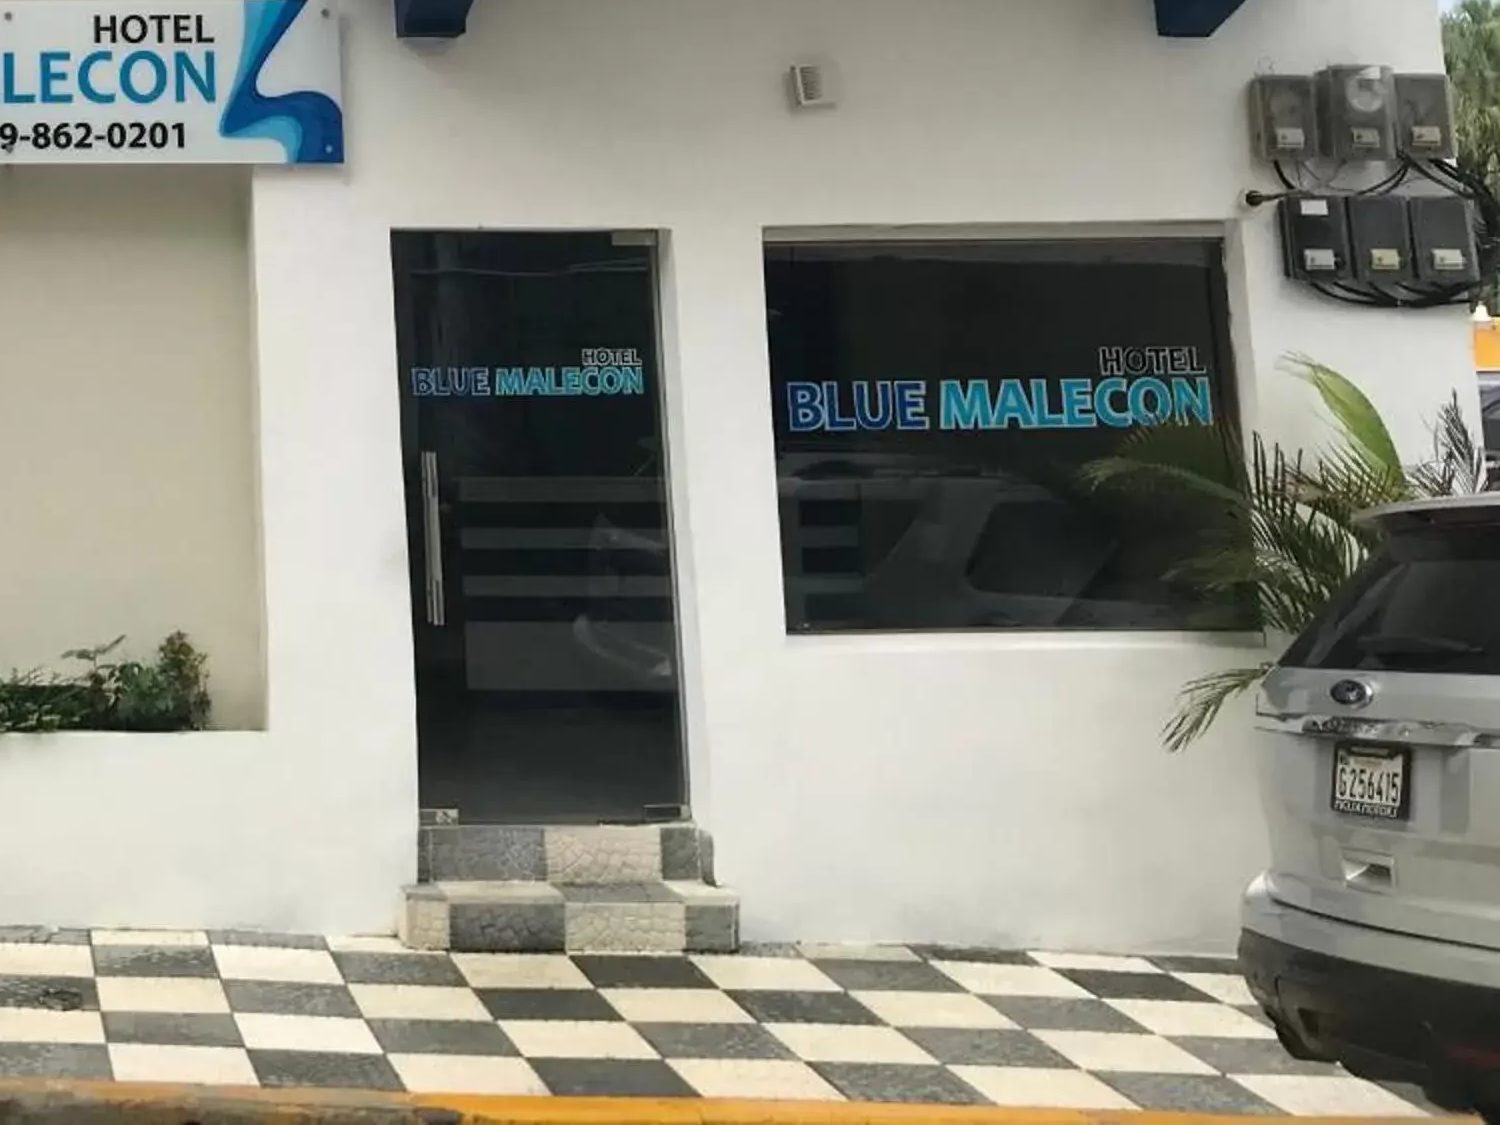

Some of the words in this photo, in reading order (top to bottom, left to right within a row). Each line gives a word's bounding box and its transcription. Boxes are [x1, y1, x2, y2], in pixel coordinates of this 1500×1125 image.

[93, 14, 215, 44] HOTEL
[581, 347, 643, 366] HOTEL
[1099, 345, 1207, 375] HOTEL
[411, 367, 491, 397] BLUE
[495, 365, 645, 396] MALECON
[786, 380, 929, 432] BLUE
[939, 375, 1215, 430] MALECON
[1338, 767, 1400, 804] G256415
